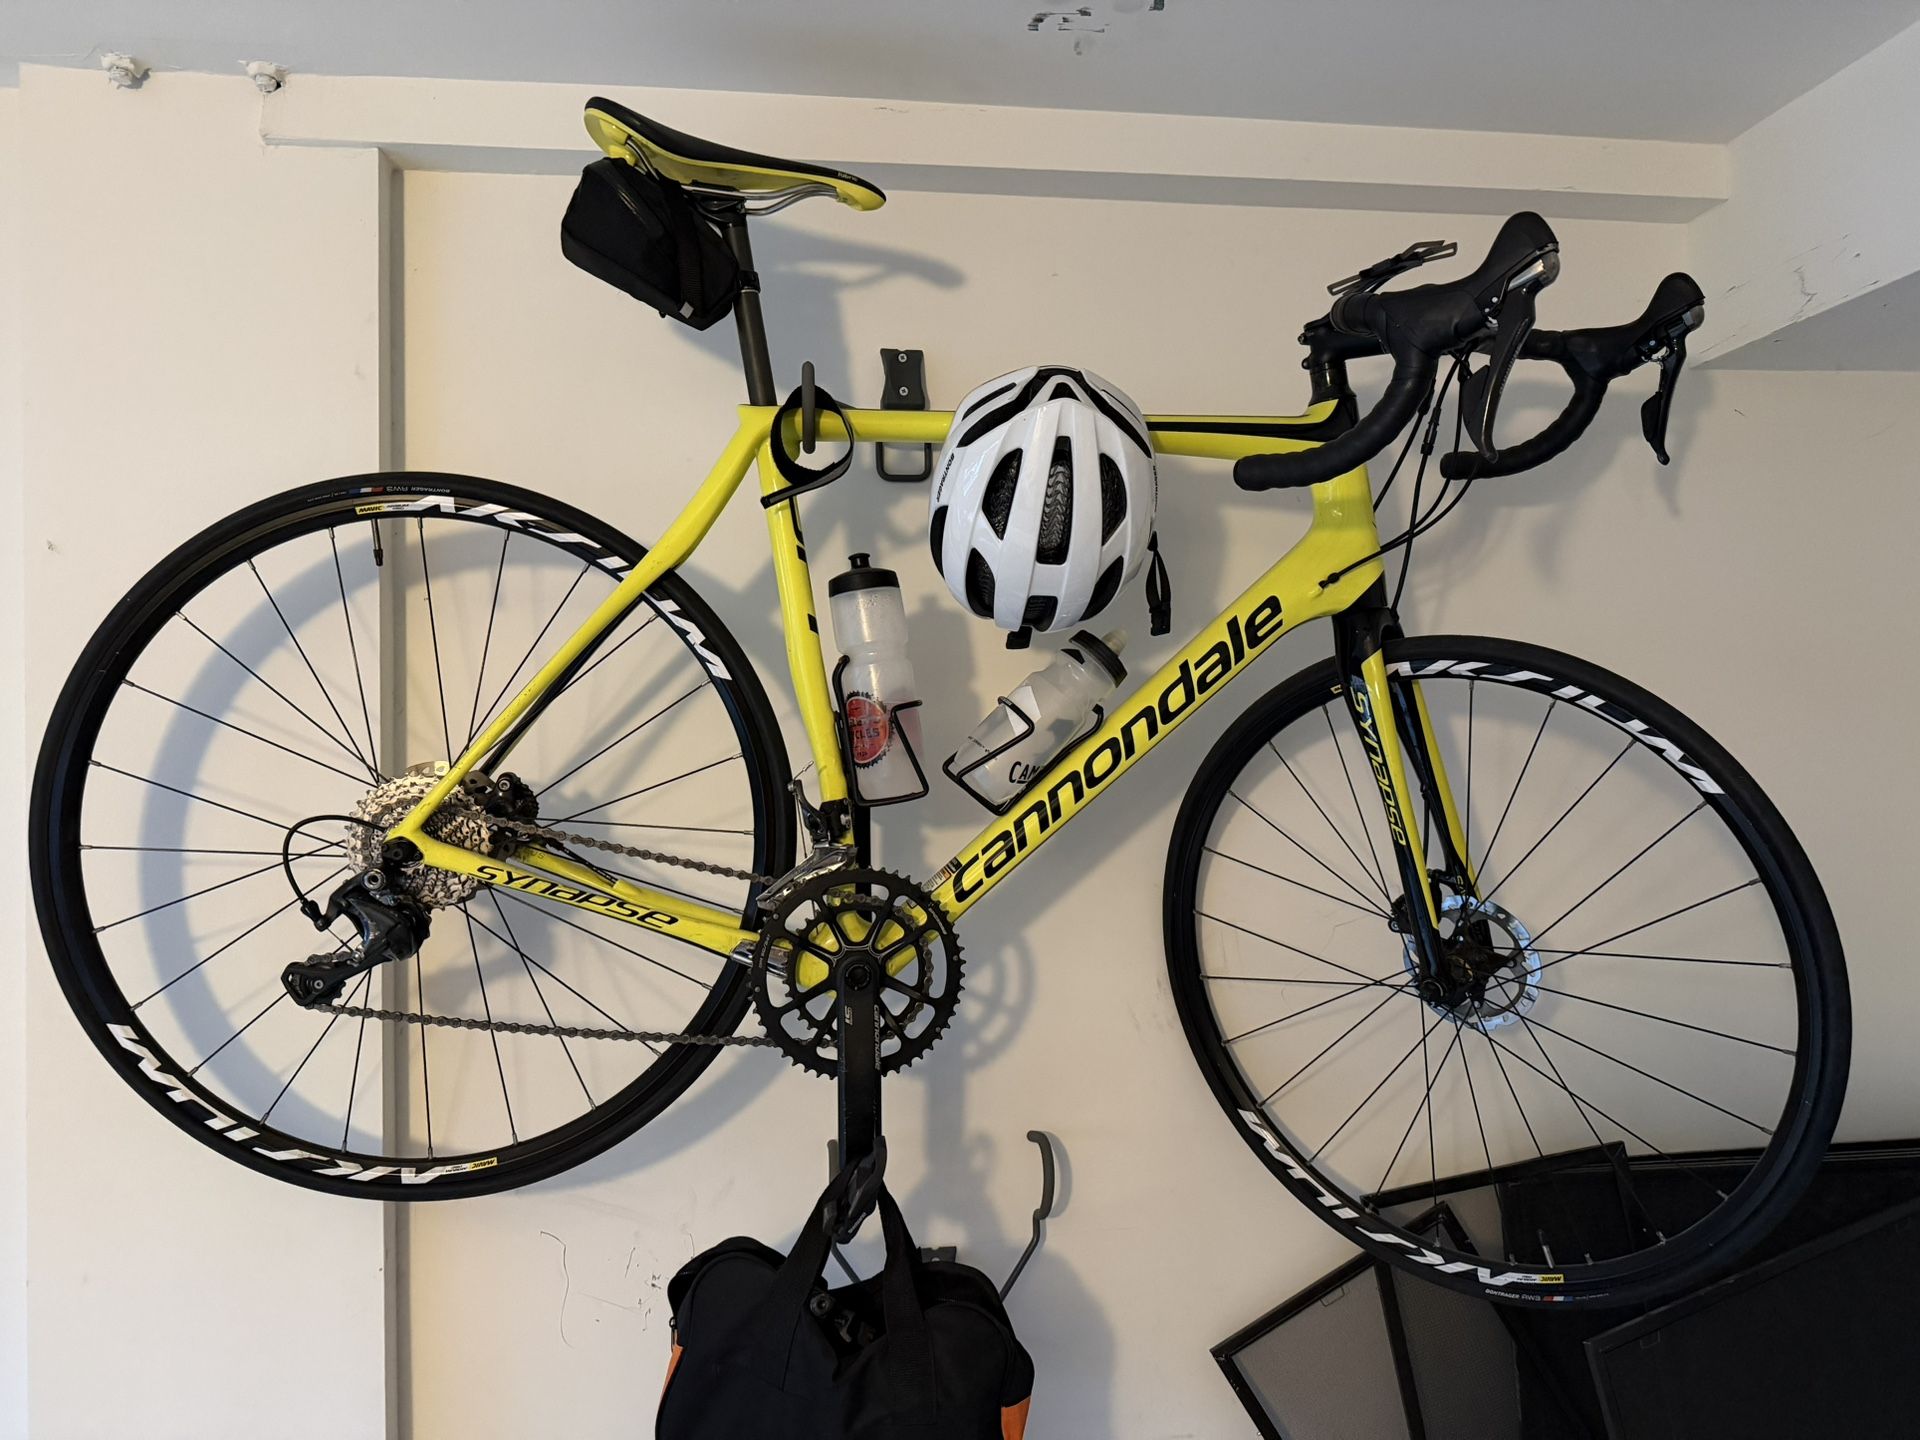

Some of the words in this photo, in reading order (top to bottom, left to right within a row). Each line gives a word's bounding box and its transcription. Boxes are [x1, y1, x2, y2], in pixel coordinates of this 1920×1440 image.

[936, 453, 955, 503] BONTRAGER
[358, 506, 382, 514] MAVIC
[952, 595, 1284, 903] cannondale
[873, 1004, 881, 1070] cannondale
[472, 1158, 496, 1168] MAVIC
[1540, 1275, 1562, 1283] MAVIC
